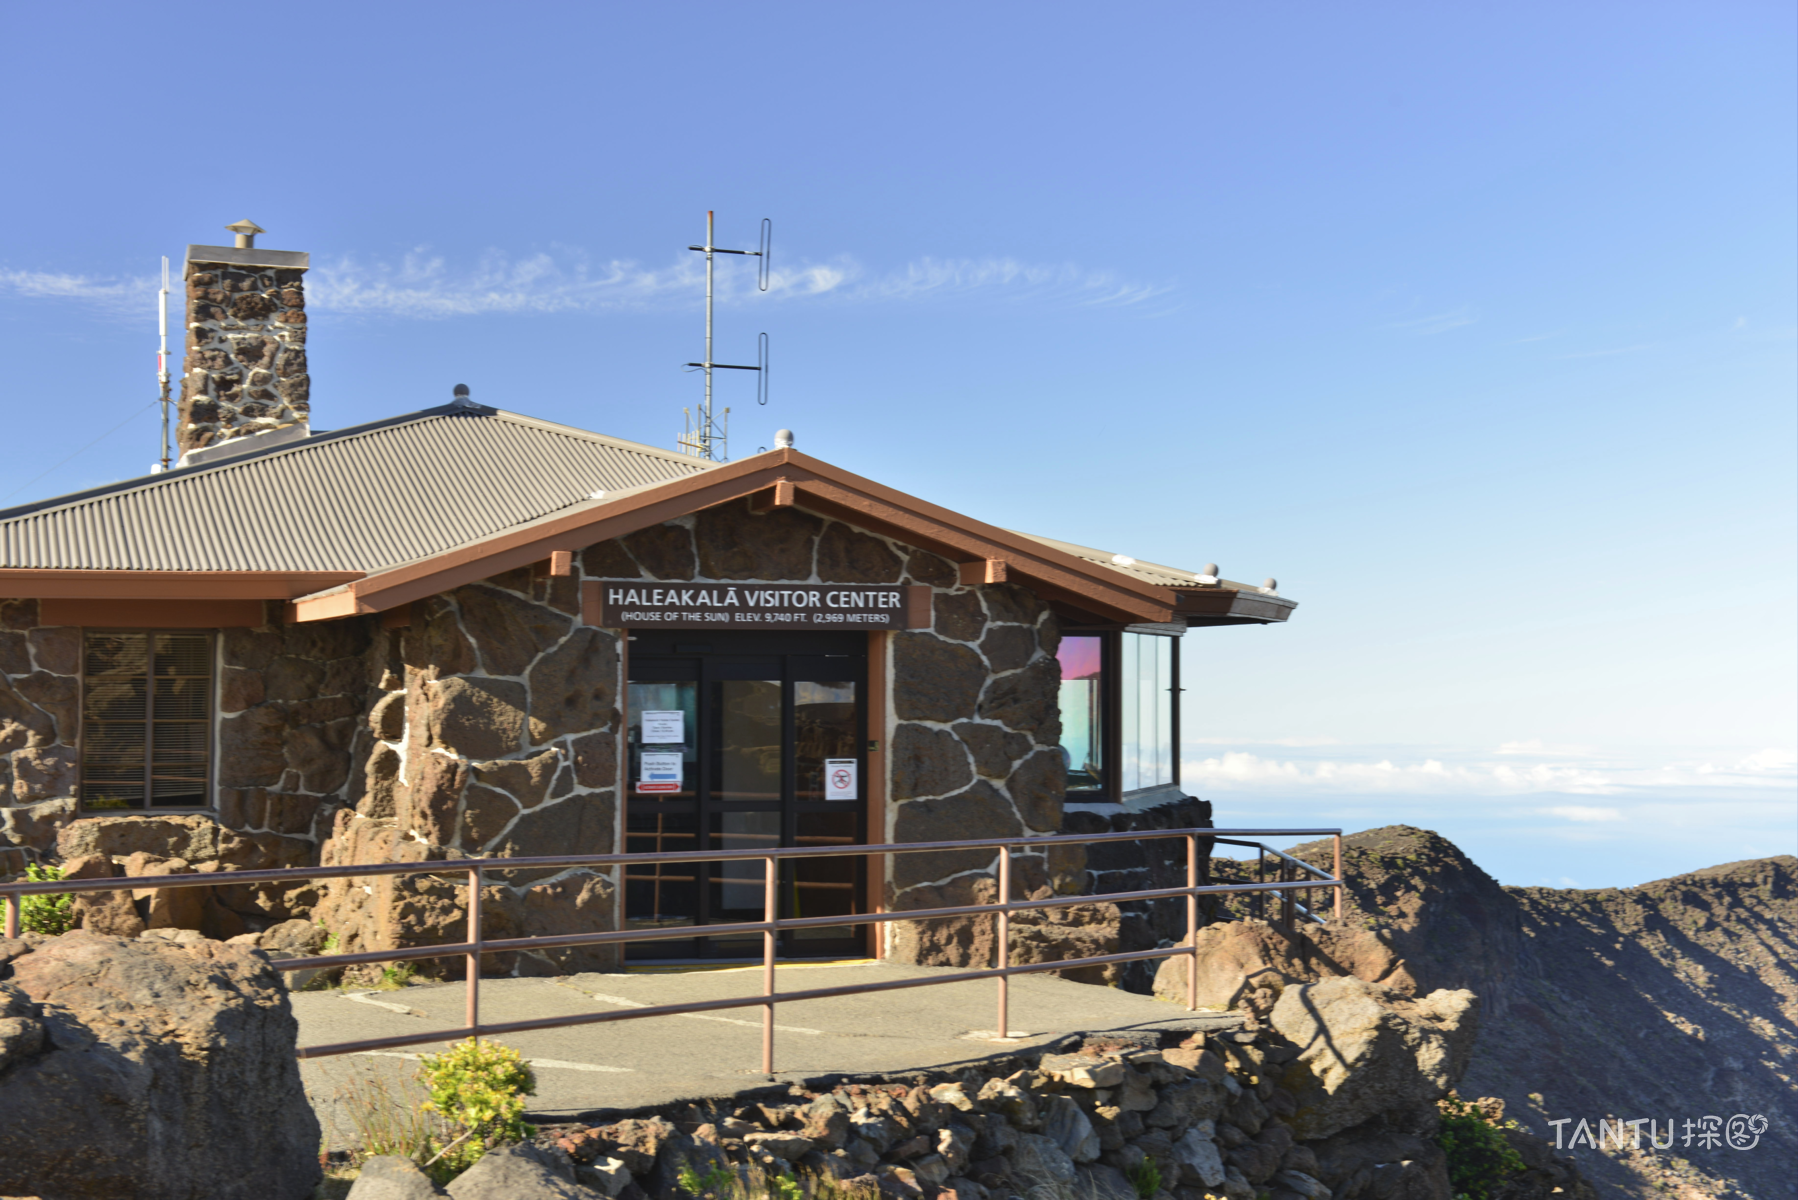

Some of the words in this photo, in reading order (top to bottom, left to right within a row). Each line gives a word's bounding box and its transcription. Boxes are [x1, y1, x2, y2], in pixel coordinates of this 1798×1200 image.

[608, 587, 740, 607] HALEAKALĀ
[744, 590, 821, 608] VISITOR
[825, 591, 901, 608] CENTER
[621, 611, 662, 622] (HOUSE
[663, 612, 680, 621] OF
[681, 612, 702, 621] THE
[704, 612, 730, 623] SUN)
[734, 612, 763, 622] ELEV.
[764, 613, 792, 623] 9,740
[793, 613, 808, 622] FT.
[812, 613, 844, 624] (2,969
[846, 613, 890, 624] METERS)
